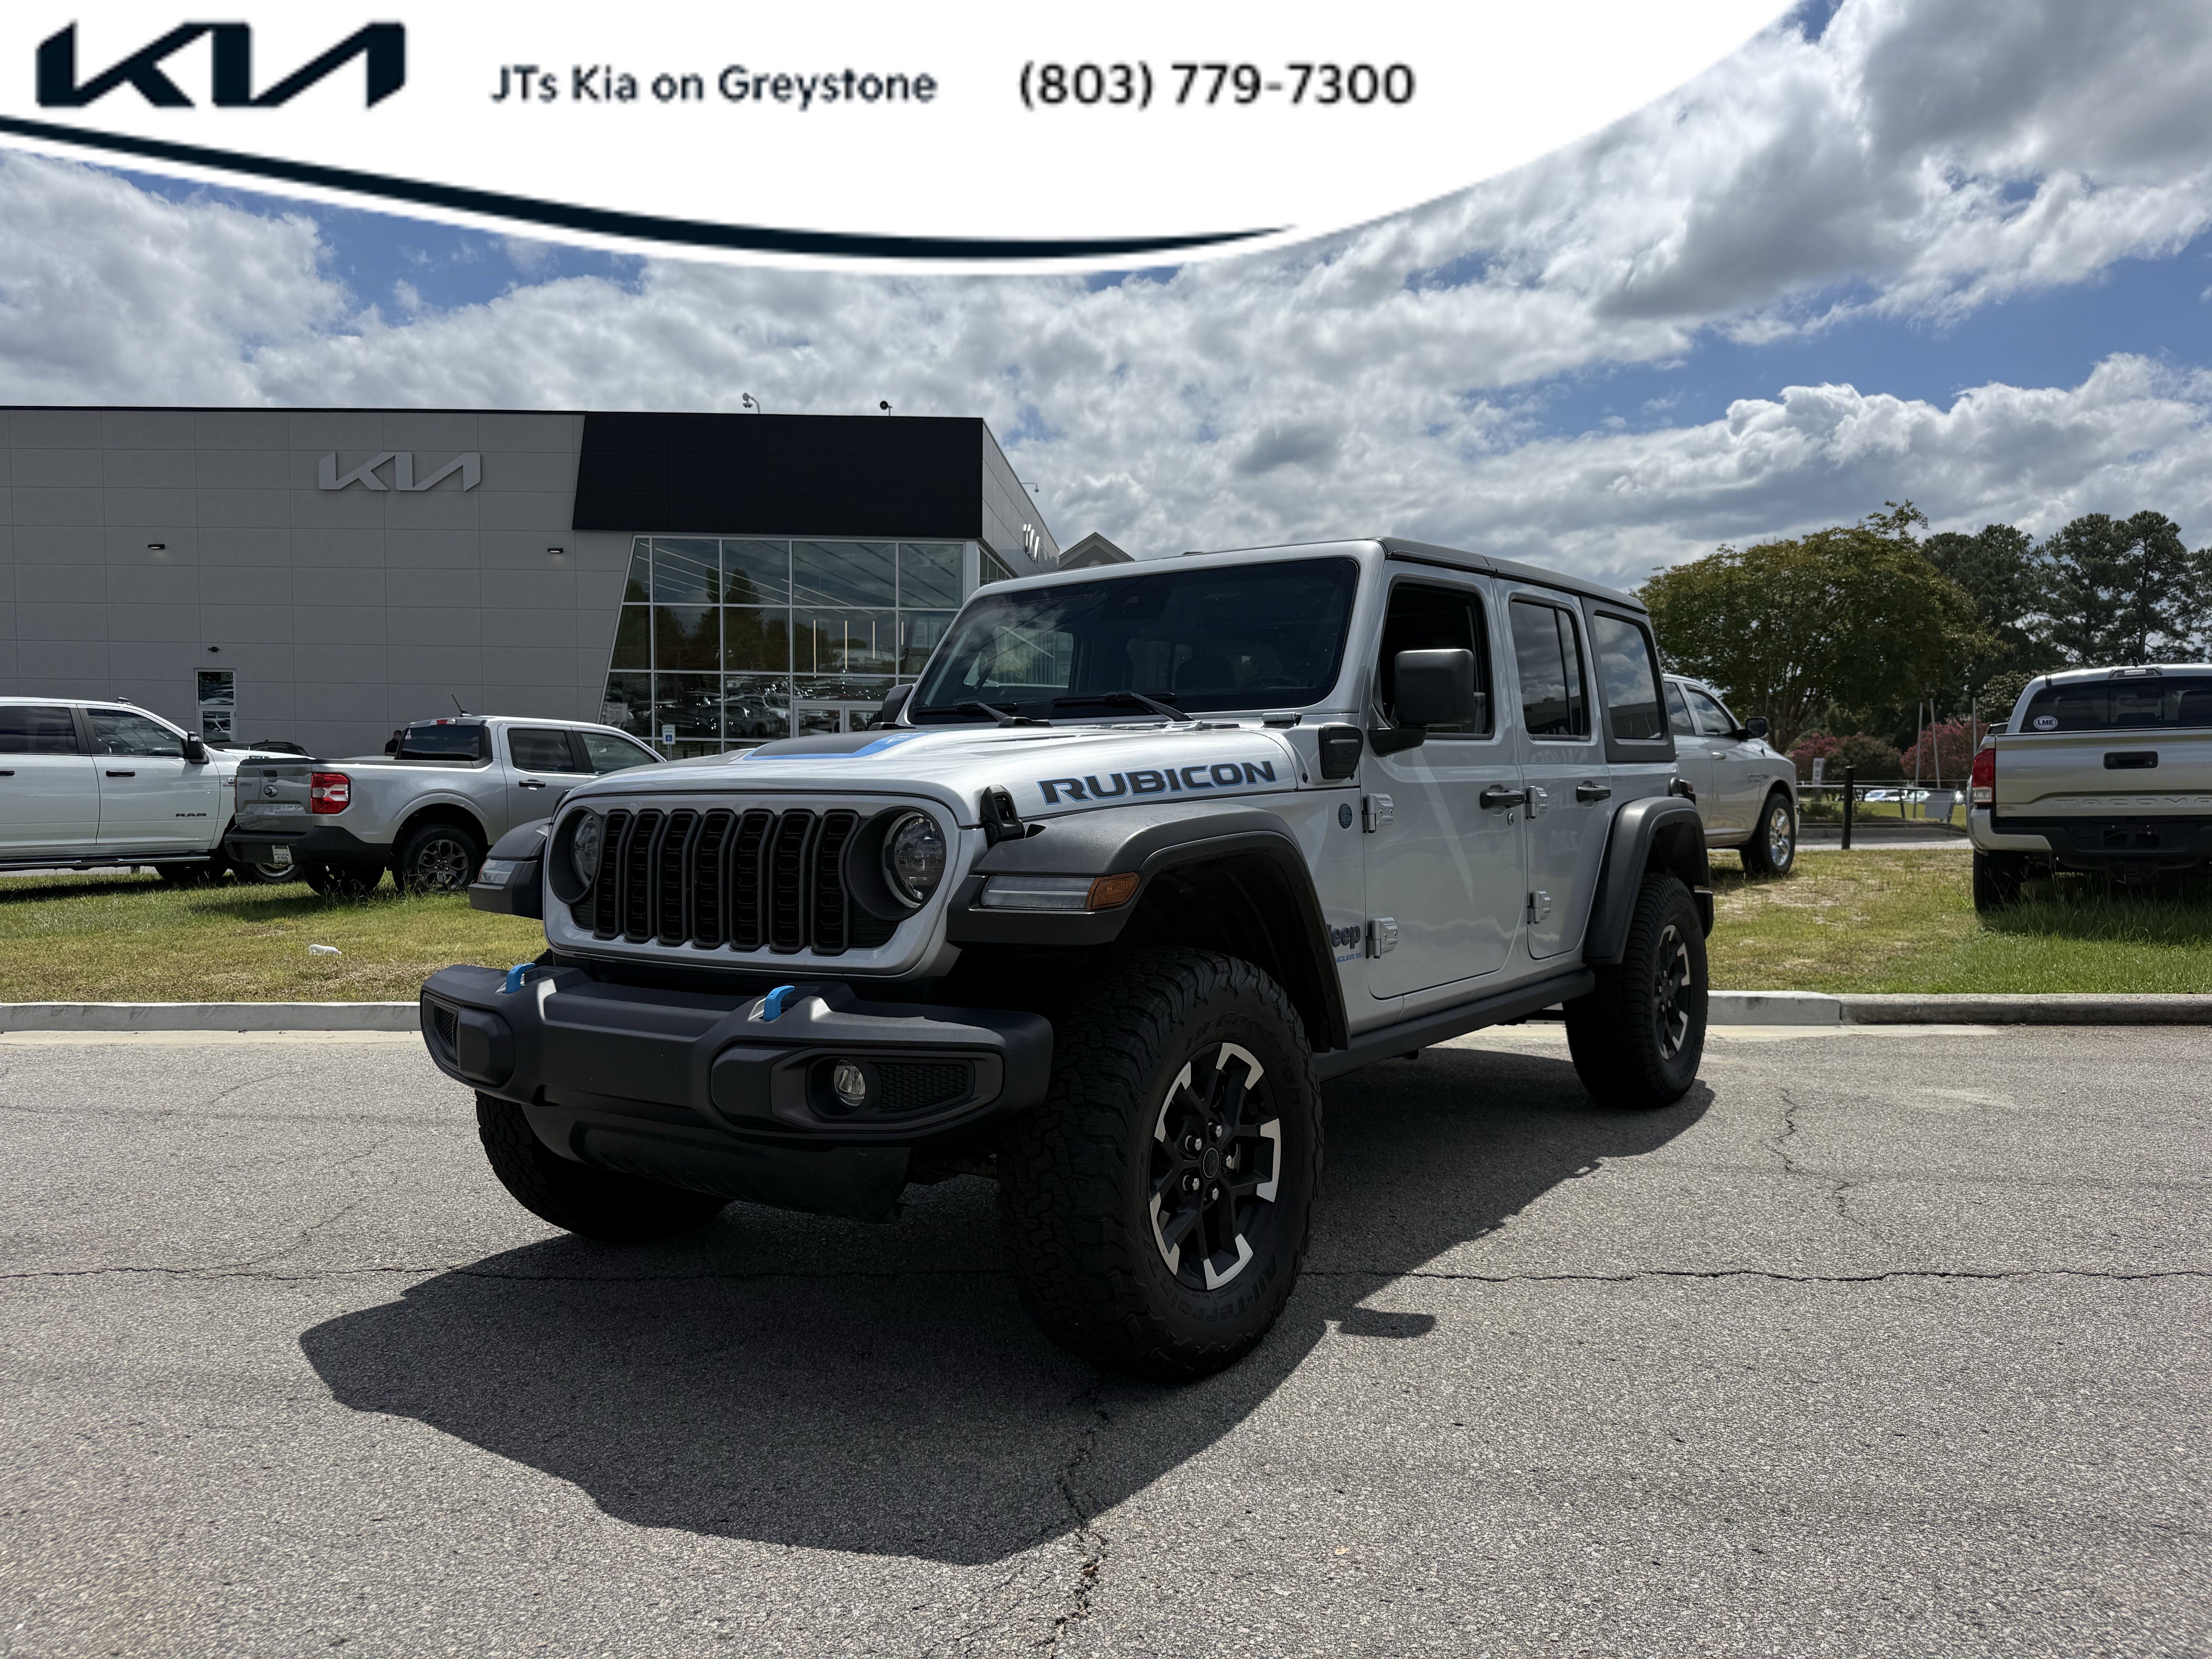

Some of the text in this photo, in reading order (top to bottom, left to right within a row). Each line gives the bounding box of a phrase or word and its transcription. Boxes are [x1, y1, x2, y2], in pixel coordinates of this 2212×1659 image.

[319, 451, 481, 491] KIA
[1037, 760, 1277, 805] RUBICON
[2054, 797, 2212, 807] TACOMA
[1335, 954, 1355, 963] NGLER
